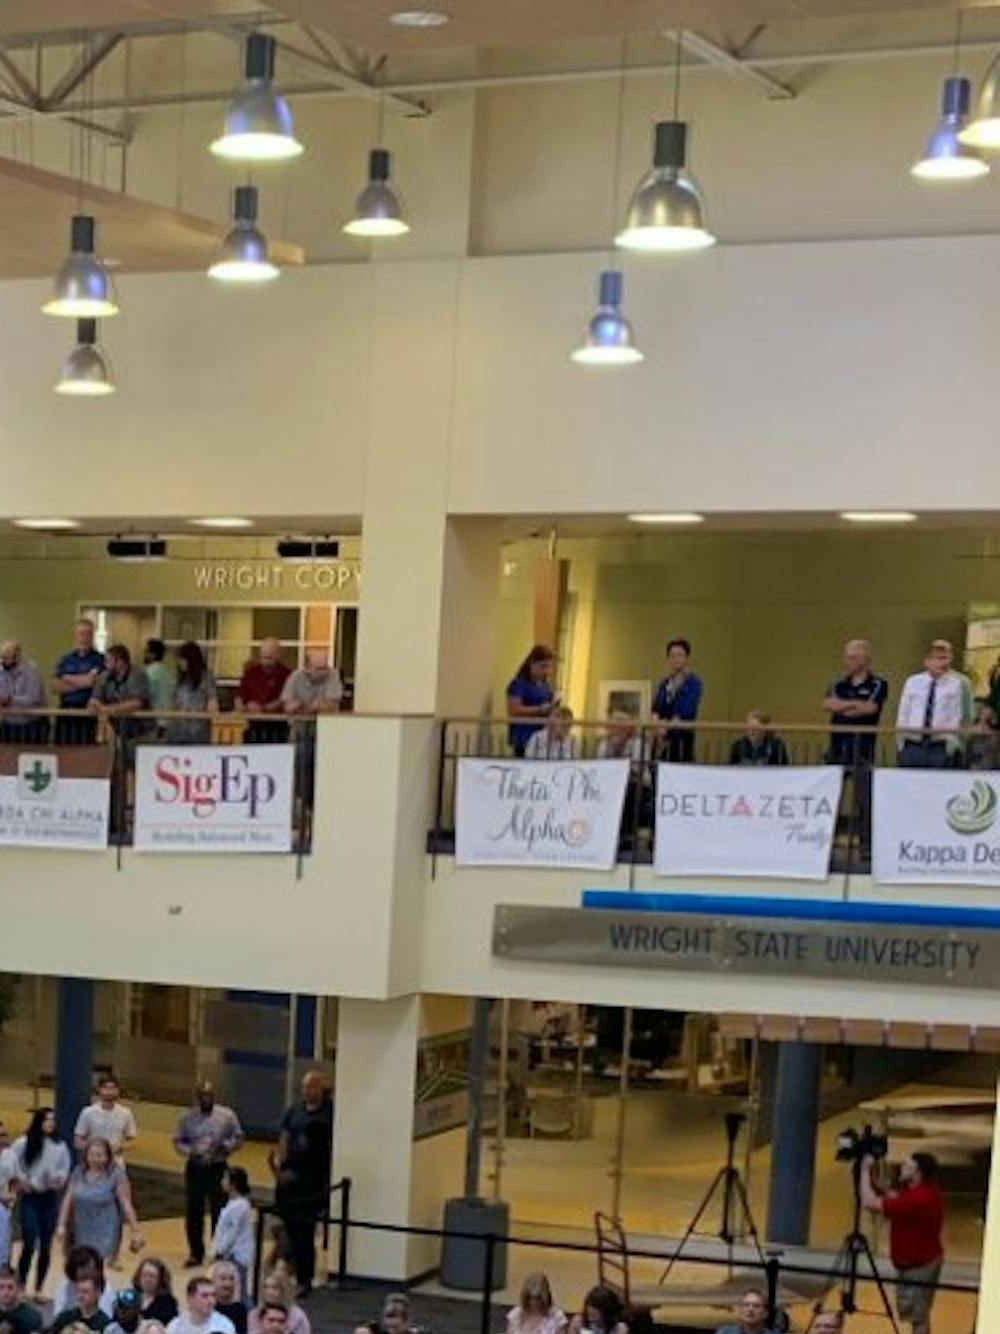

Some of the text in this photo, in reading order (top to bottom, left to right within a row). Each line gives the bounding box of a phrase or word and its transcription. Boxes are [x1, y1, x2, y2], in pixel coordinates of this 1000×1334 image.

[194, 565, 283, 588] WRIGHT
[154, 754, 276, 819] SigEp
[485, 765, 602, 801] Theta Phi
[660, 793, 832, 818] DELTA ZETA
[485, 803, 570, 852] Alpha
[899, 840, 1000, 865] Kappa De
[610, 923, 982, 969] WRIGHT STATE UNIVERSITY
